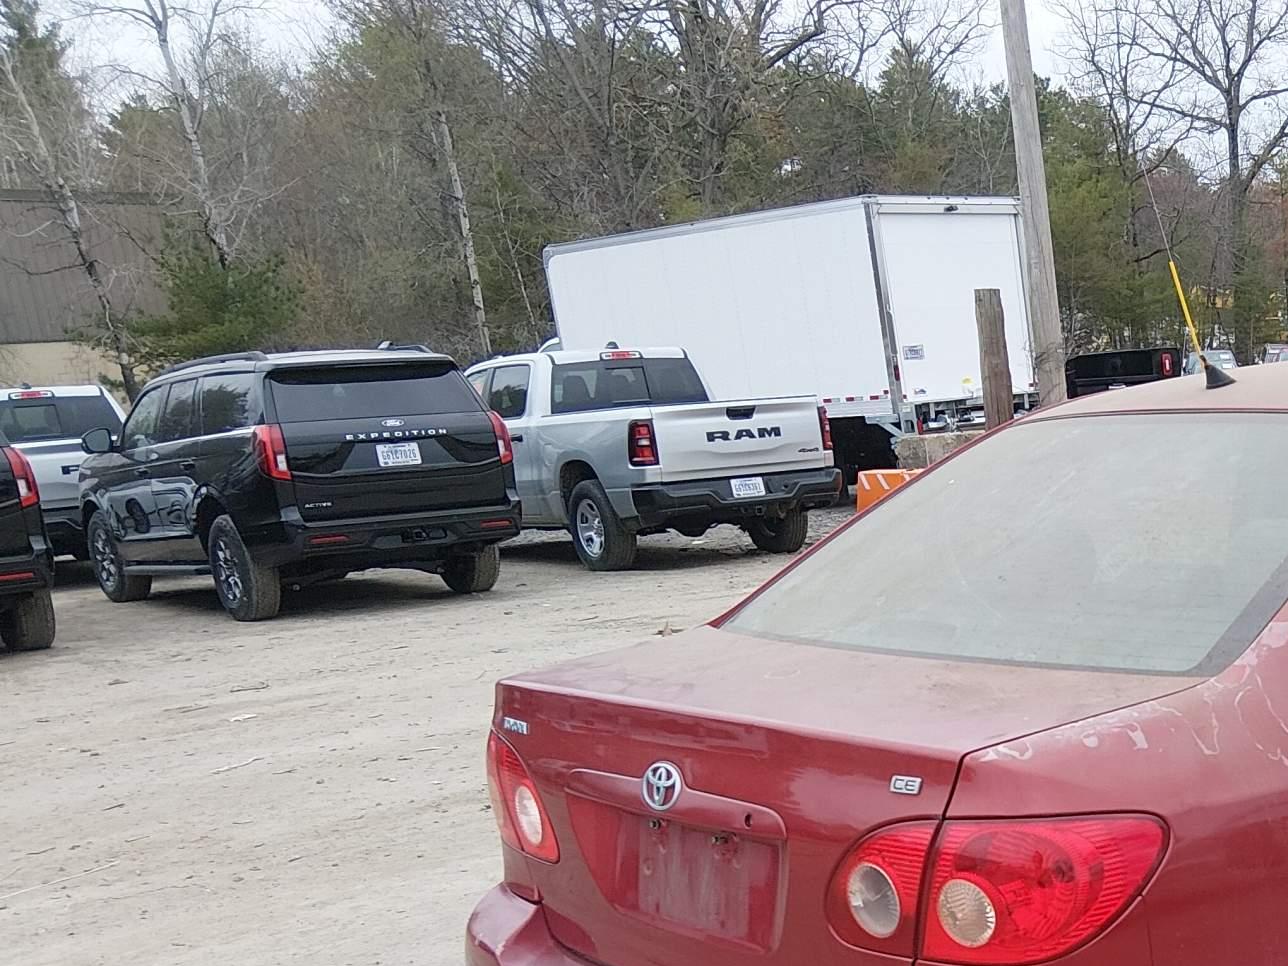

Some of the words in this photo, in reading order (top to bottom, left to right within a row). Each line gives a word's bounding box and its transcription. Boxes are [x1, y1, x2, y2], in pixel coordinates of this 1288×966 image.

[345, 428, 447, 441] EXPEDITION
[706, 426, 782, 443] RAM
[304, 501, 333, 509] ACTIVE
[892, 777, 918, 792] CE
